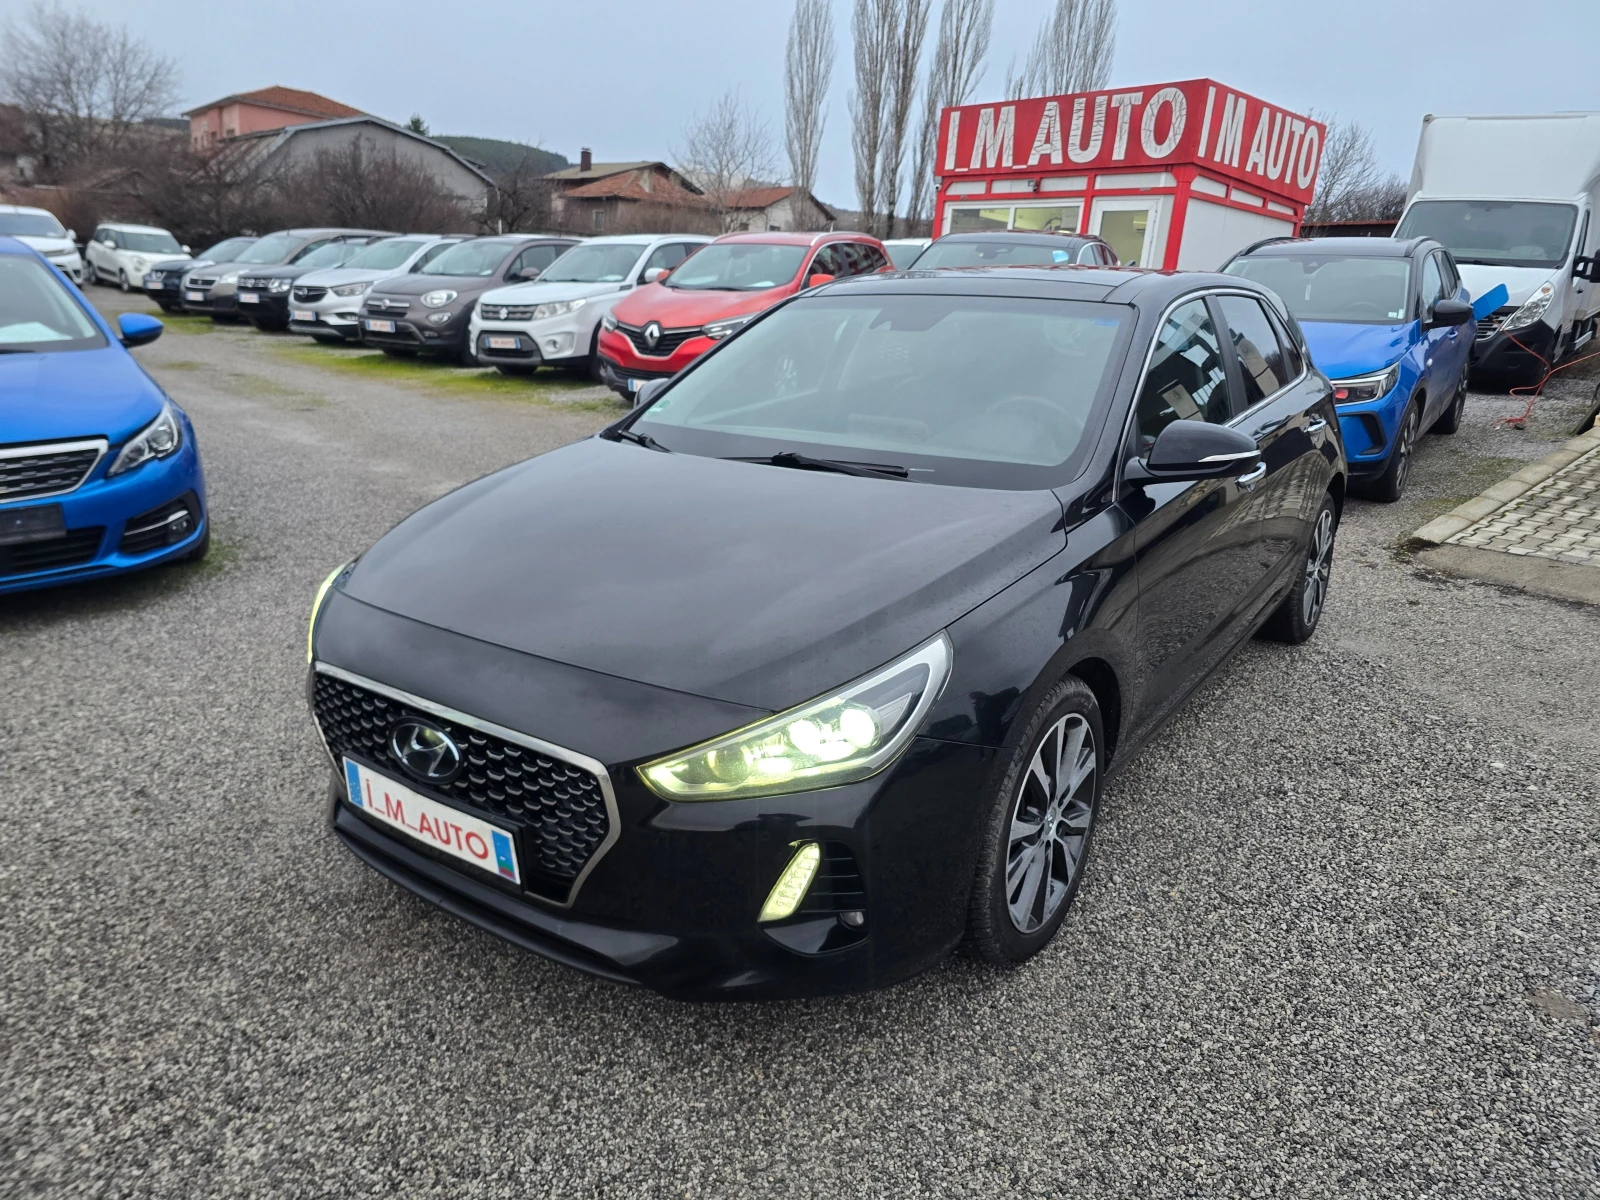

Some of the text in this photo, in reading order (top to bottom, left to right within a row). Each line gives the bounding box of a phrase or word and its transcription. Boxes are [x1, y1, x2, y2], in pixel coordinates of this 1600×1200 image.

[1197, 85, 1319, 190] I M AUTO
